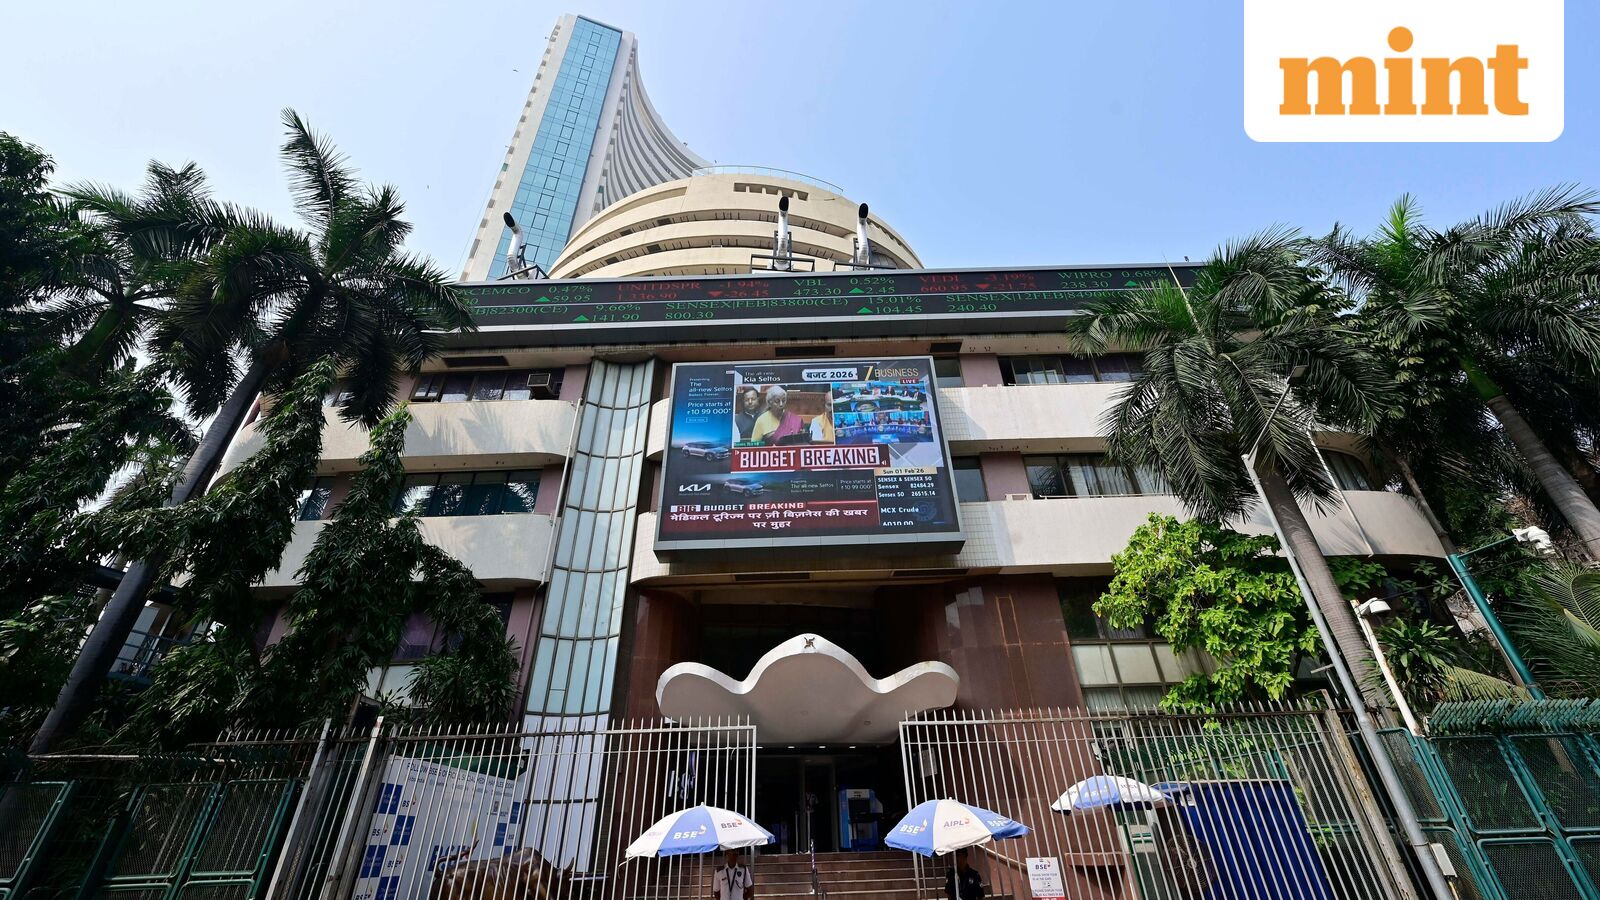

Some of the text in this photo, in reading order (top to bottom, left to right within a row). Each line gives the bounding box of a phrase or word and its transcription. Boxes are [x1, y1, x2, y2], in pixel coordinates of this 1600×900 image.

[1057, 270, 1168, 280] WIPRO 0.68%
[849, 276, 896, 286] 0.52%
[1062, 280, 1110, 290] 238.30
[548, 285, 593, 294] 0.47%
[792, 286, 896, 296] 473.30 2.45
[551, 294, 591, 303] 59.95
[868, 296, 922, 304] 15.01%
[596, 304, 641, 312] 9.66%
[948, 303, 998, 312] 240.40
[592, 312, 640, 322] 141.90
[664, 306, 923, 320] 800.30 104.45
[806, 370, 854, 379] बजट 2026
[874, 368, 919, 378] BUSINESS
[740, 448, 877, 468] BUDGET BREAKING
[704, 504, 744, 512] BUDGET
[750, 502, 804, 510] BREAKING
[825, 508, 840, 517] की
[720, 822, 738, 830] BSE
[943, 818, 965, 828] AIPL
[900, 824, 921, 834] BSE
[673, 830, 698, 840] BSE
